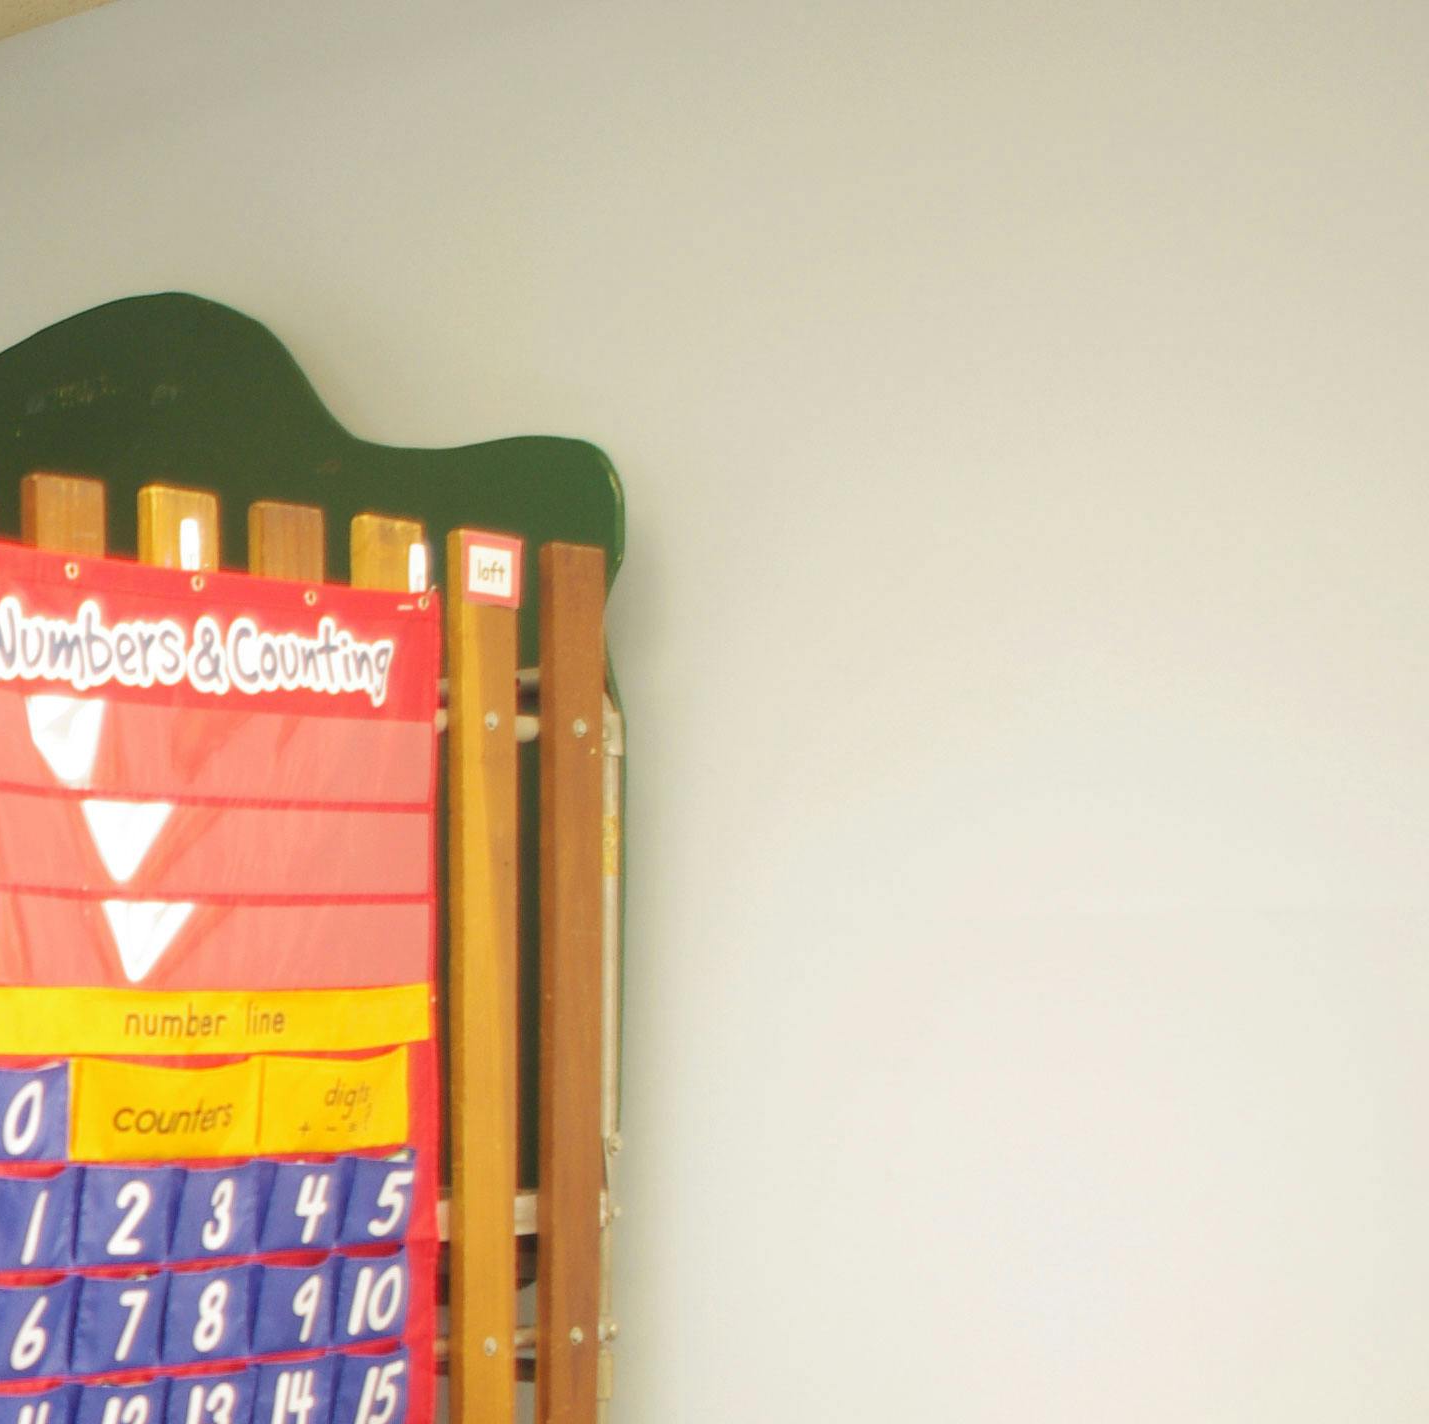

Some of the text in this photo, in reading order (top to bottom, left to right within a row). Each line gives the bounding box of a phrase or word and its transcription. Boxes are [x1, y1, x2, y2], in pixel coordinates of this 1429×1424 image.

[476, 557, 506, 585] loft
[191, 620, 227, 690] &
[230, 619, 393, 703] Counting
[123, 1000, 286, 1038] number line
[2, 1079, 44, 1156] 0
[112, 1098, 234, 1135] counters
[21, 1170, 415, 1265] 1 2 3 4 5
[10, 1264, 404, 1370] 6 7 8 9 10
